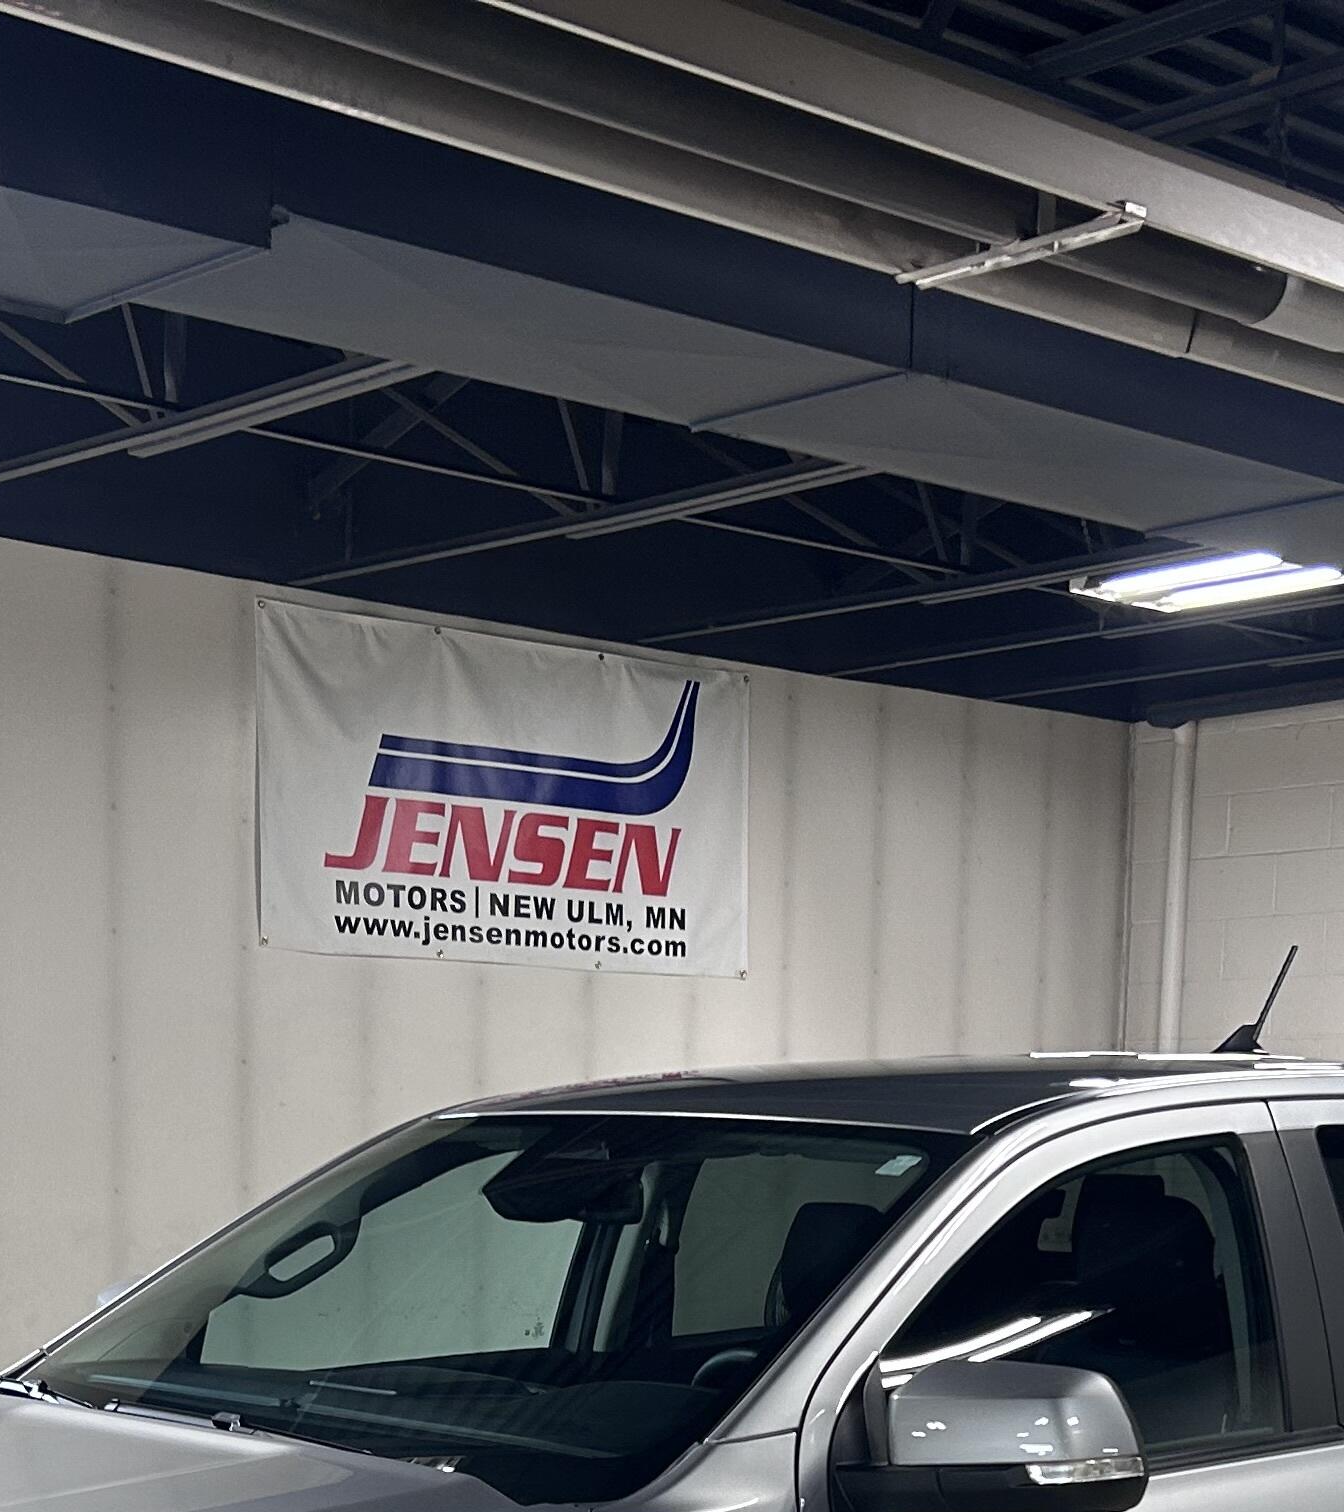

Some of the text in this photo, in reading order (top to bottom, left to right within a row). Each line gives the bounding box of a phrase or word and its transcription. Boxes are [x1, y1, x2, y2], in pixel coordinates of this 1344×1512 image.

[324, 794, 682, 897] JENSEN
[335, 880, 467, 914] MOTORS
[489, 893, 557, 921] NEW
[567, 900, 633, 932] ULM,
[645, 906, 687, 931] MN
[334, 915, 688, 958] www.jensenmotors.com
